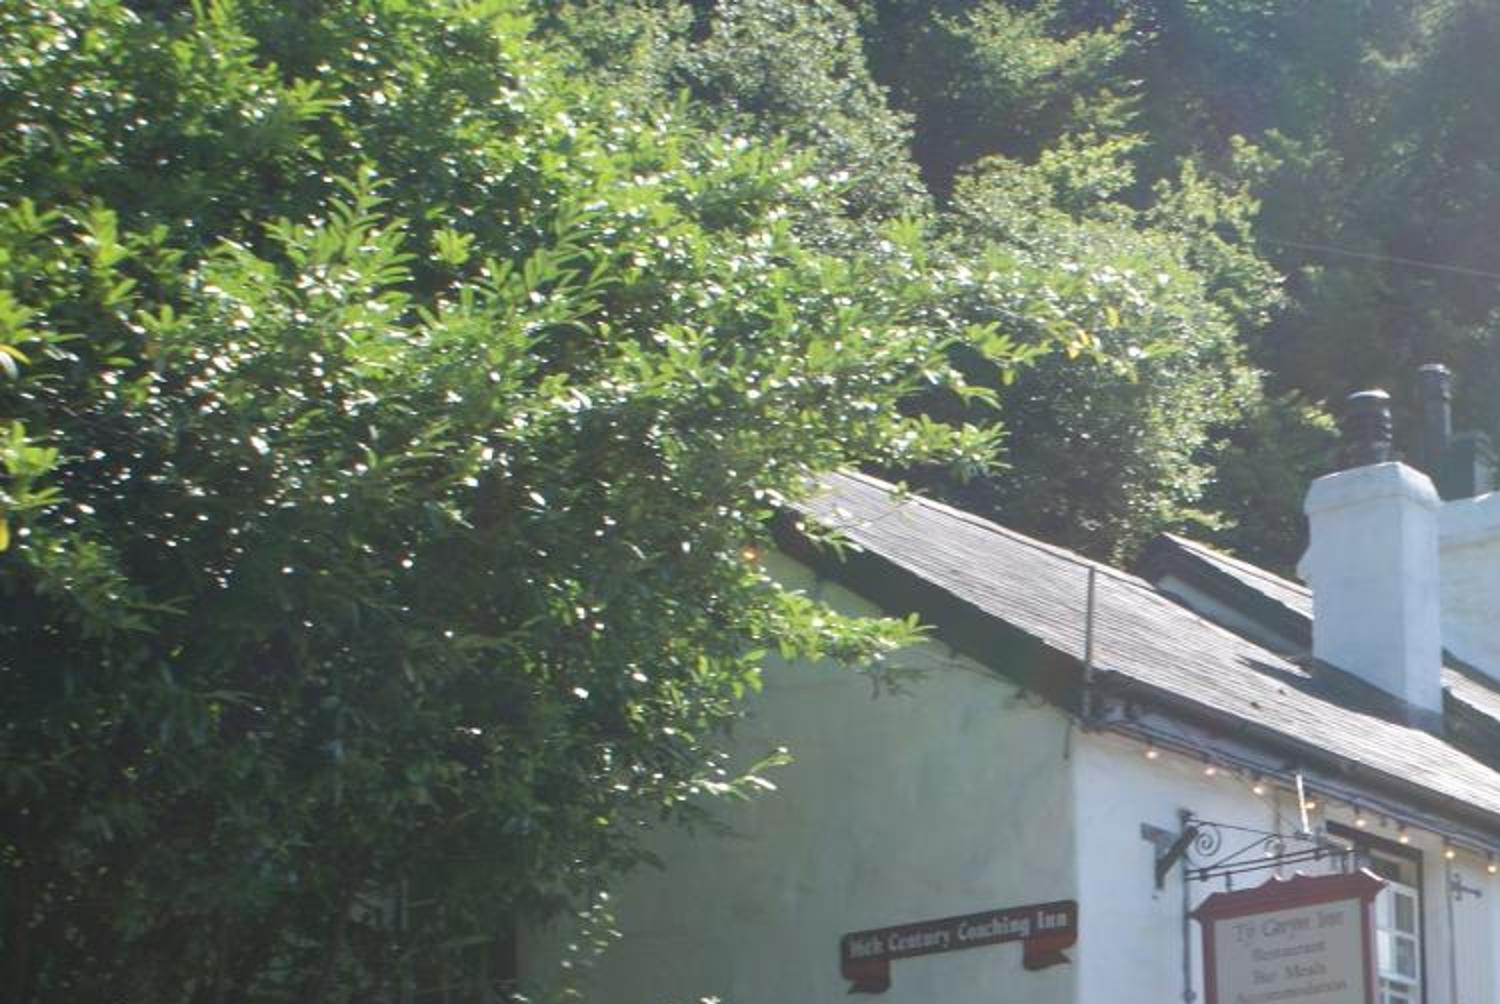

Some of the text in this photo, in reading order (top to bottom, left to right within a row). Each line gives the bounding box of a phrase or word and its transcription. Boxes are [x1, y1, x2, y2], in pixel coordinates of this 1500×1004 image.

[888, 929, 950, 952] Century
[957, 916, 1031, 941] Coaching
[1037, 910, 1068, 929] Inn
